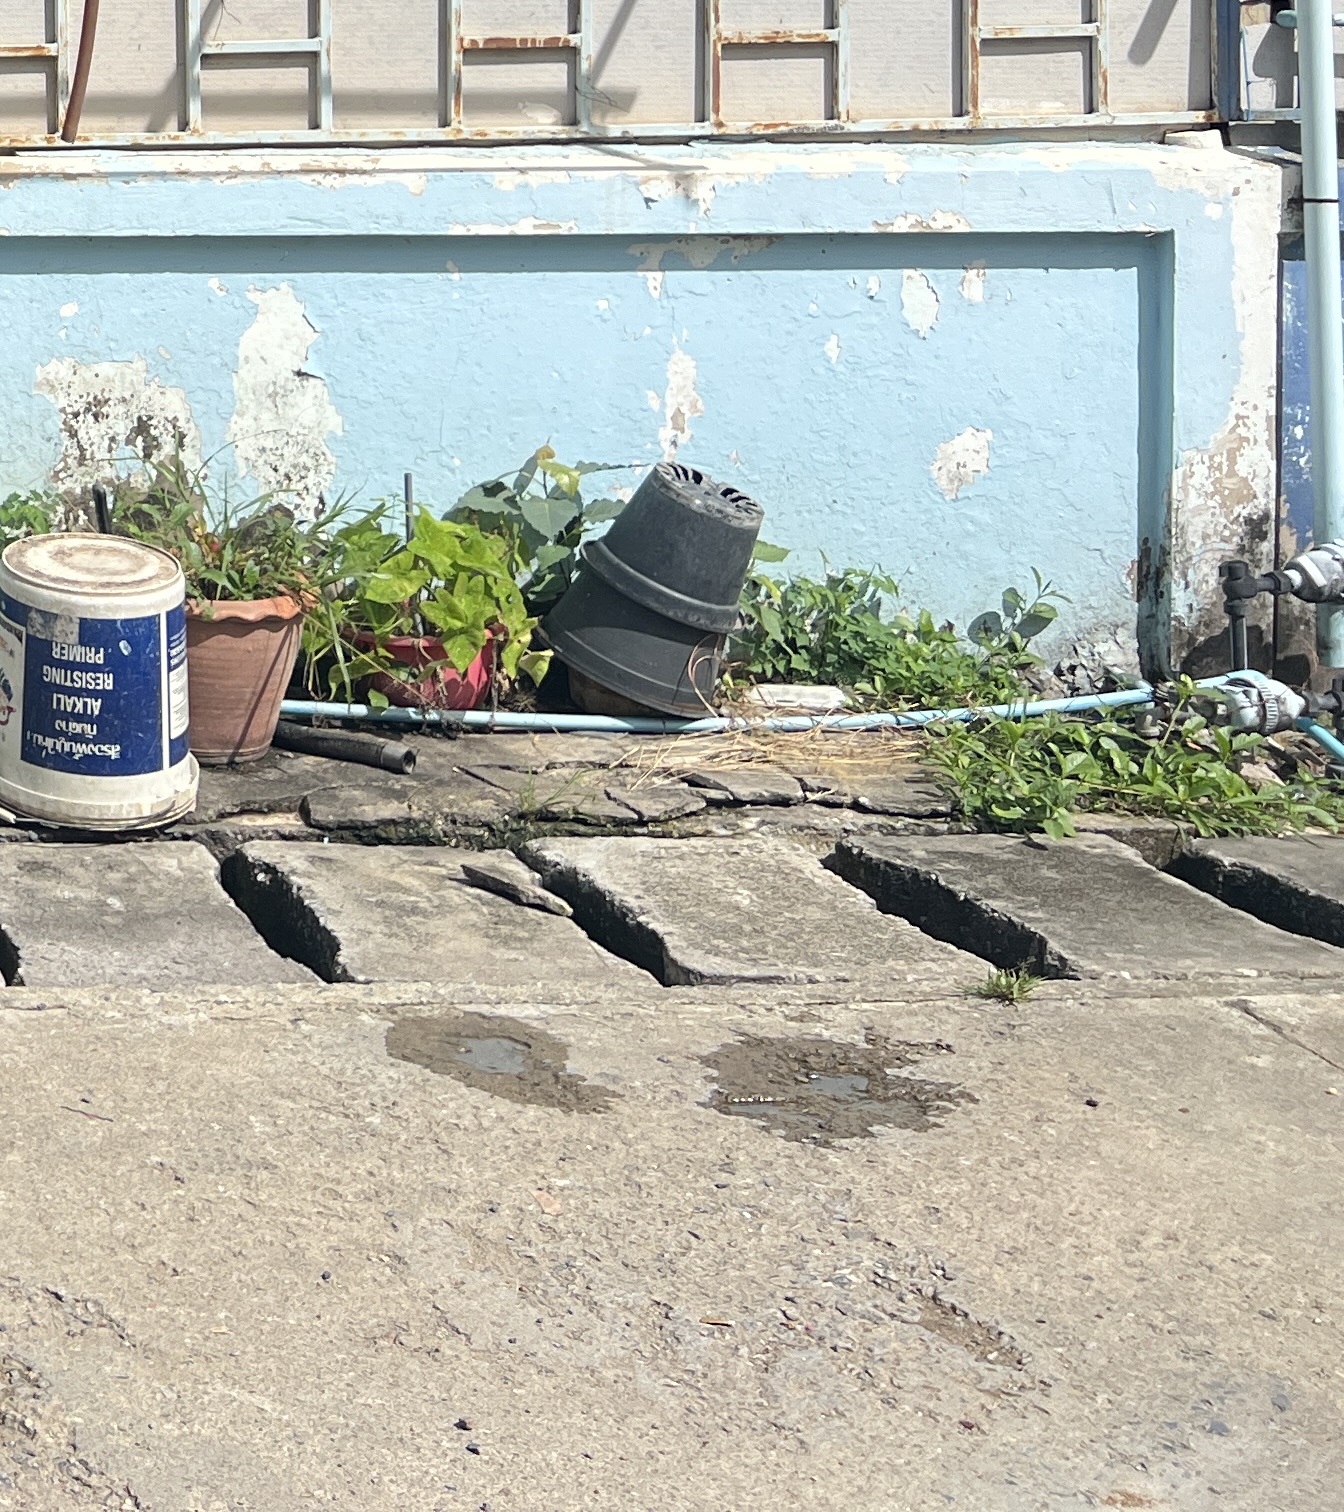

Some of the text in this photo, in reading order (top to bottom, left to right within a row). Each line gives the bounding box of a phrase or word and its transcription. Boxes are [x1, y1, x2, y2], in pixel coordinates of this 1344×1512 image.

[51, 641, 104, 665] PRIMER
[42, 664, 114, 690] RESISTING
[52, 692, 102, 716] ALKALI
